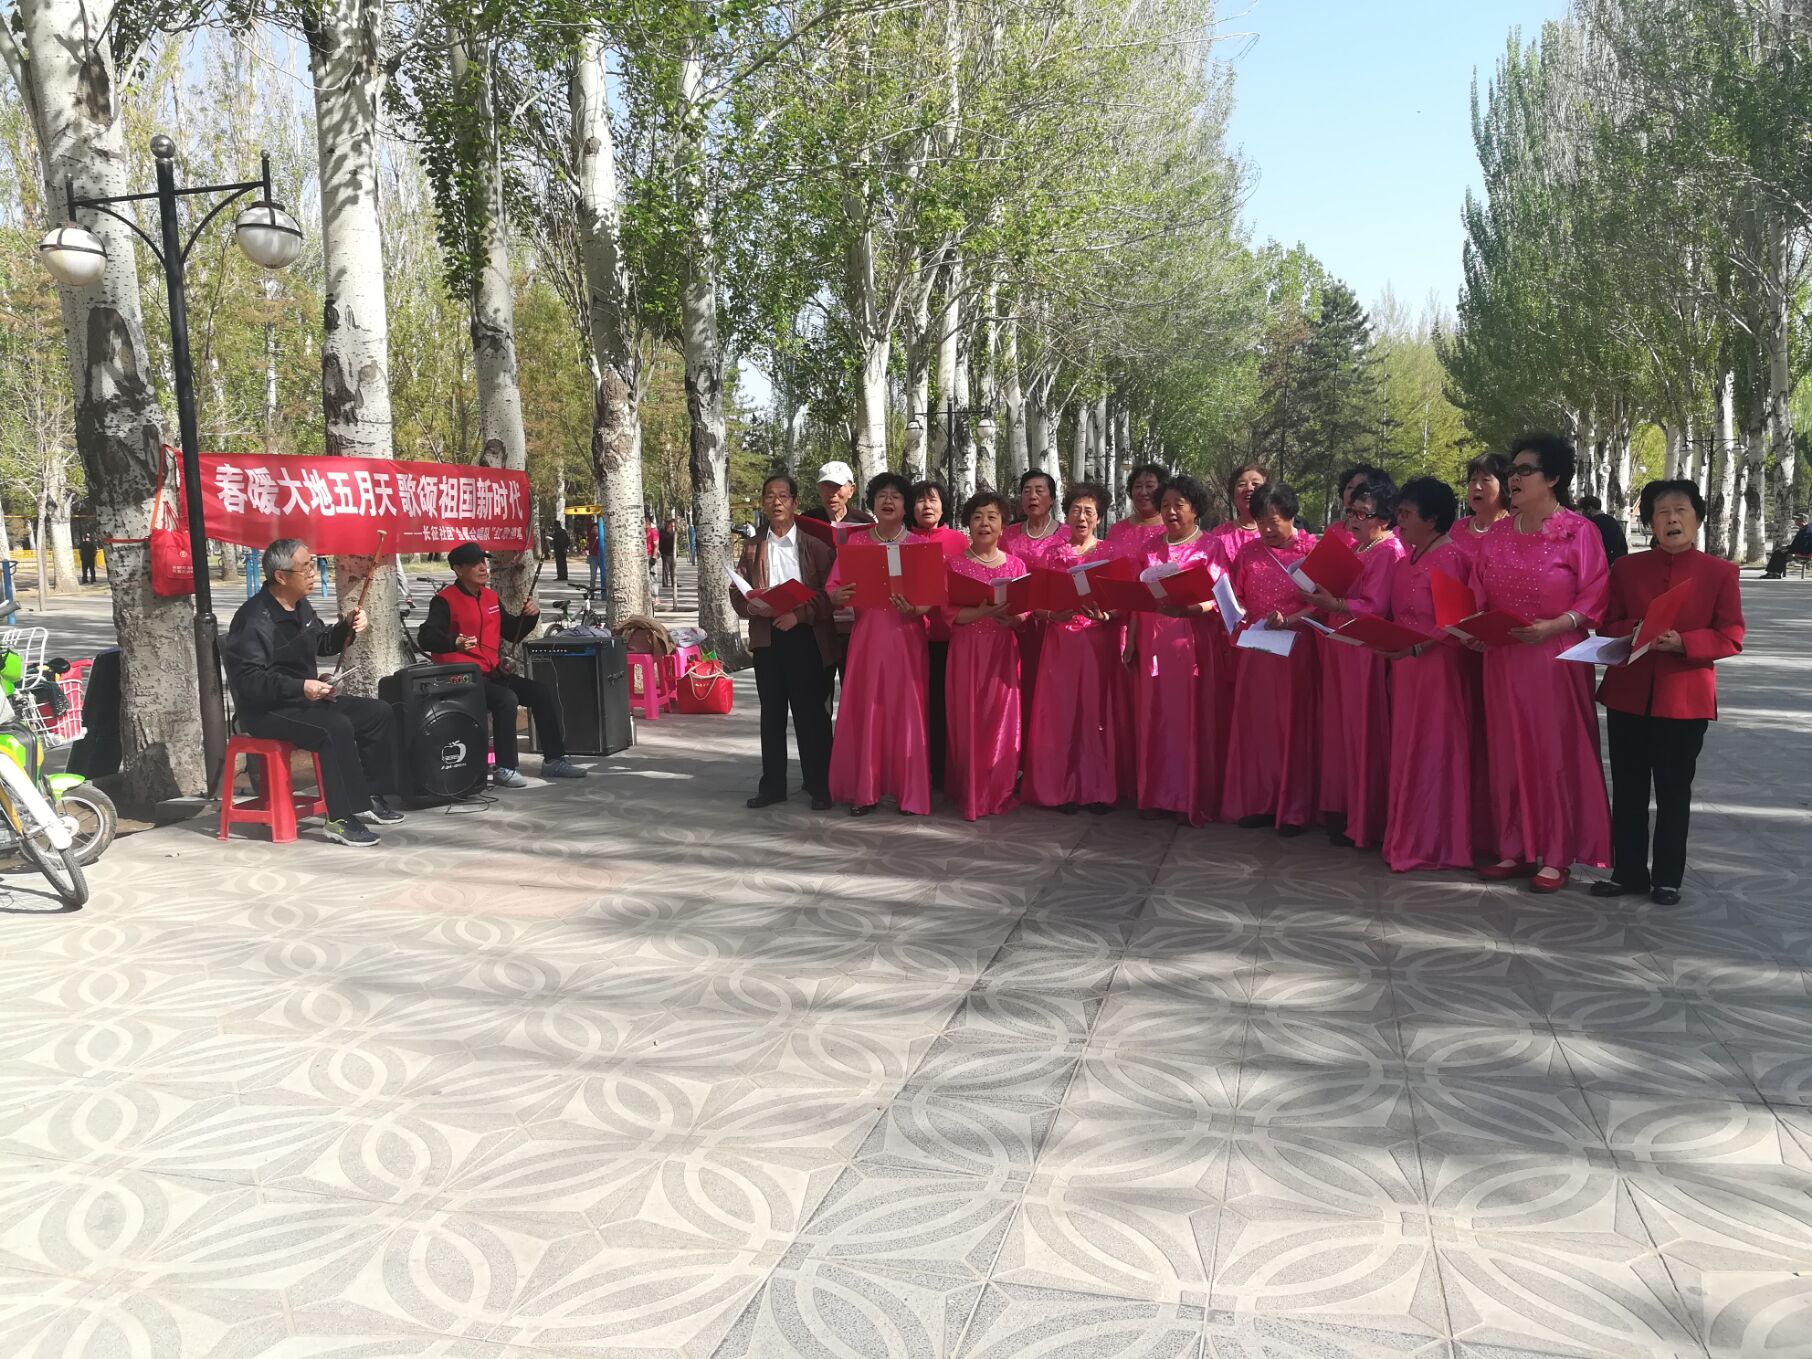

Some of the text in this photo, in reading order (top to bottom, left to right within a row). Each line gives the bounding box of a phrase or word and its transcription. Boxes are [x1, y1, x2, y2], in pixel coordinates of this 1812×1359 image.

[215, 463, 523, 520] 春暖大地五月天 歌颂祖国新时代
